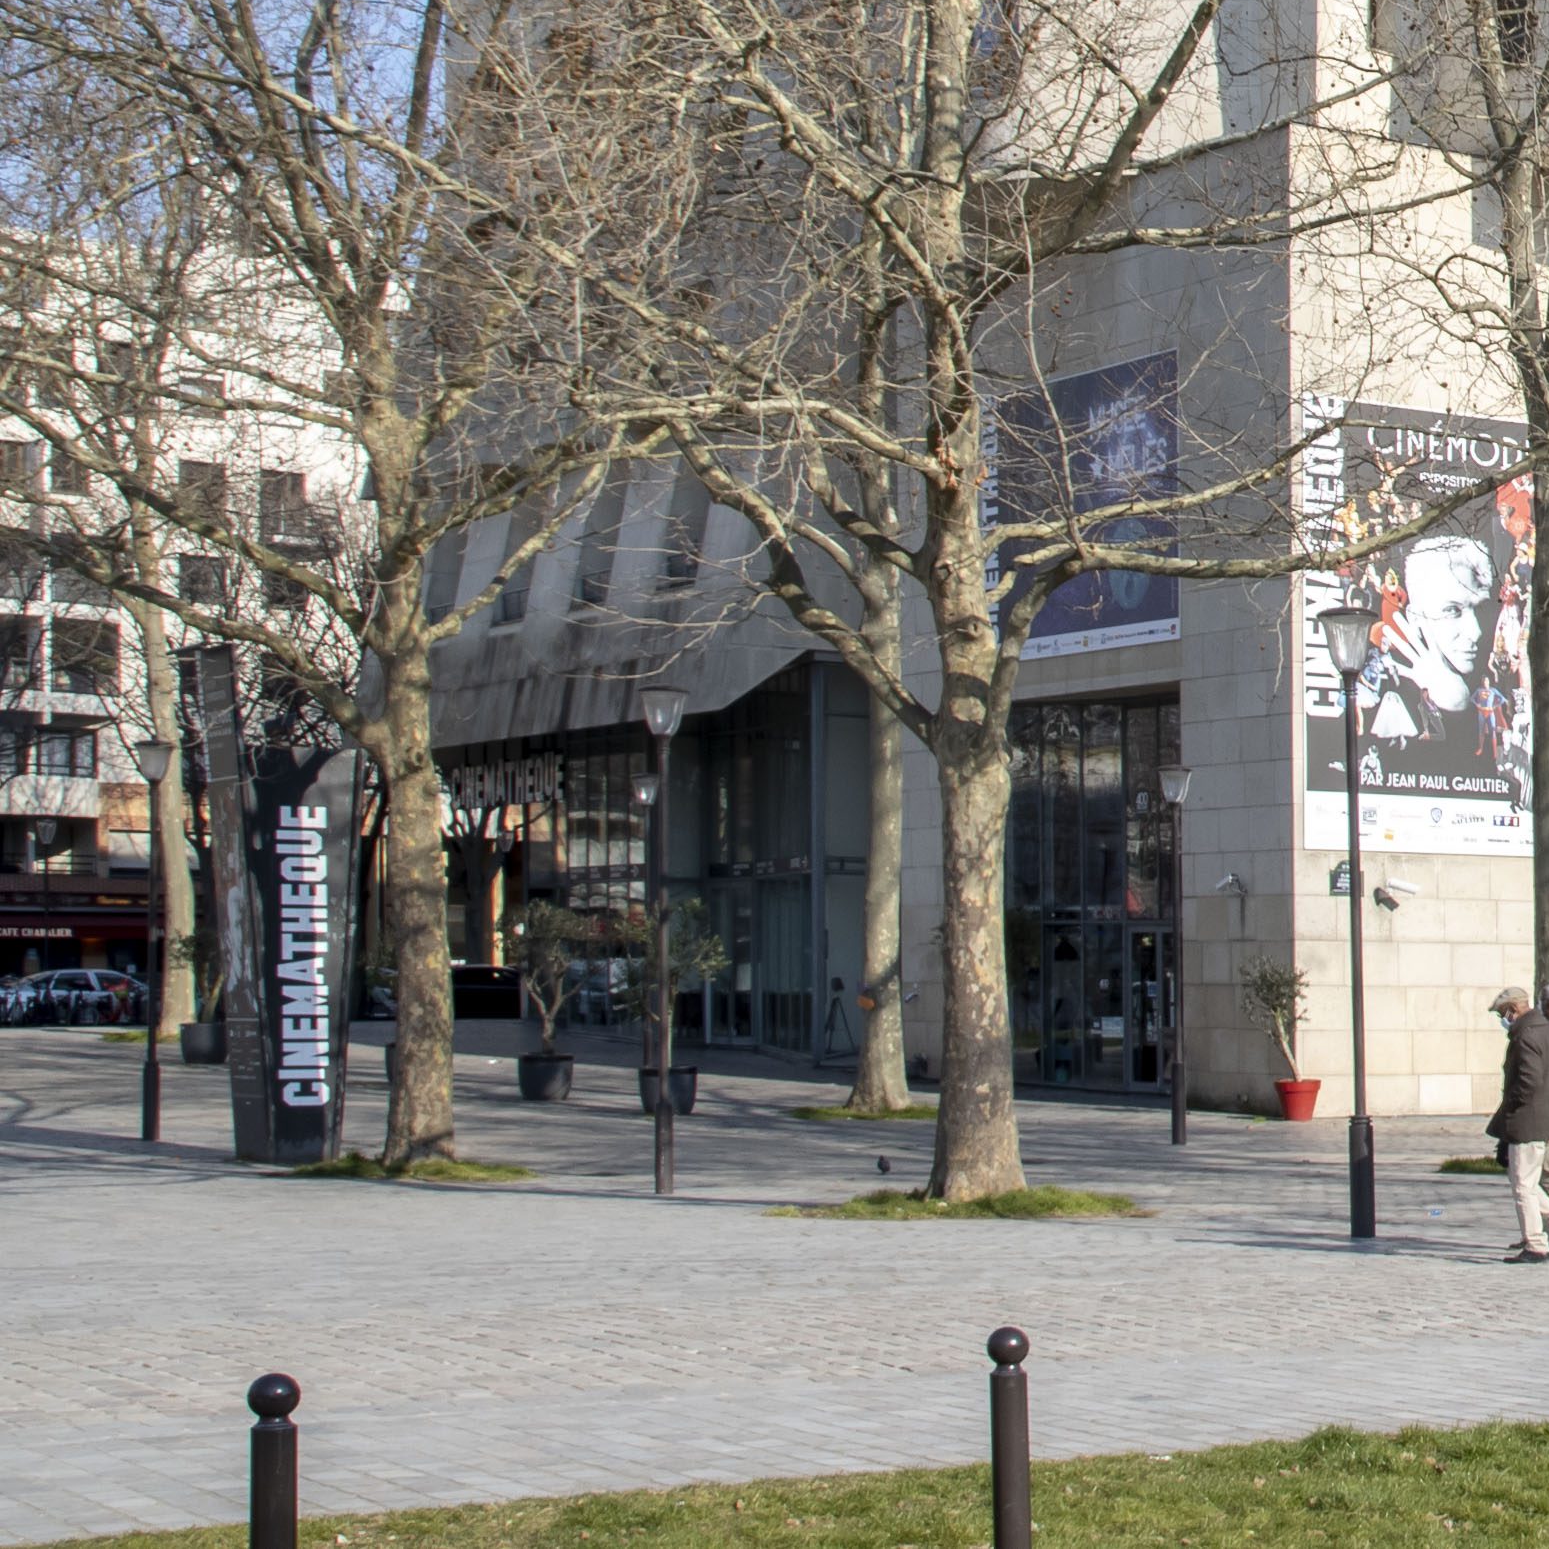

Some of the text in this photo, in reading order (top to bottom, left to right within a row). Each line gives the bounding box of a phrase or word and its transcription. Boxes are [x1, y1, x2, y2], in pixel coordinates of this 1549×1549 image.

[1368, 419, 1530, 471] CINÉMOD
[1419, 472, 1483, 488] EXPOSITIO
[452, 752, 564, 808] CINEMATHEQUE
[1360, 772, 1509, 794] PAR JEAN PAUL GAULTIER
[275, 805, 331, 1107] CINEMATHEQUE
